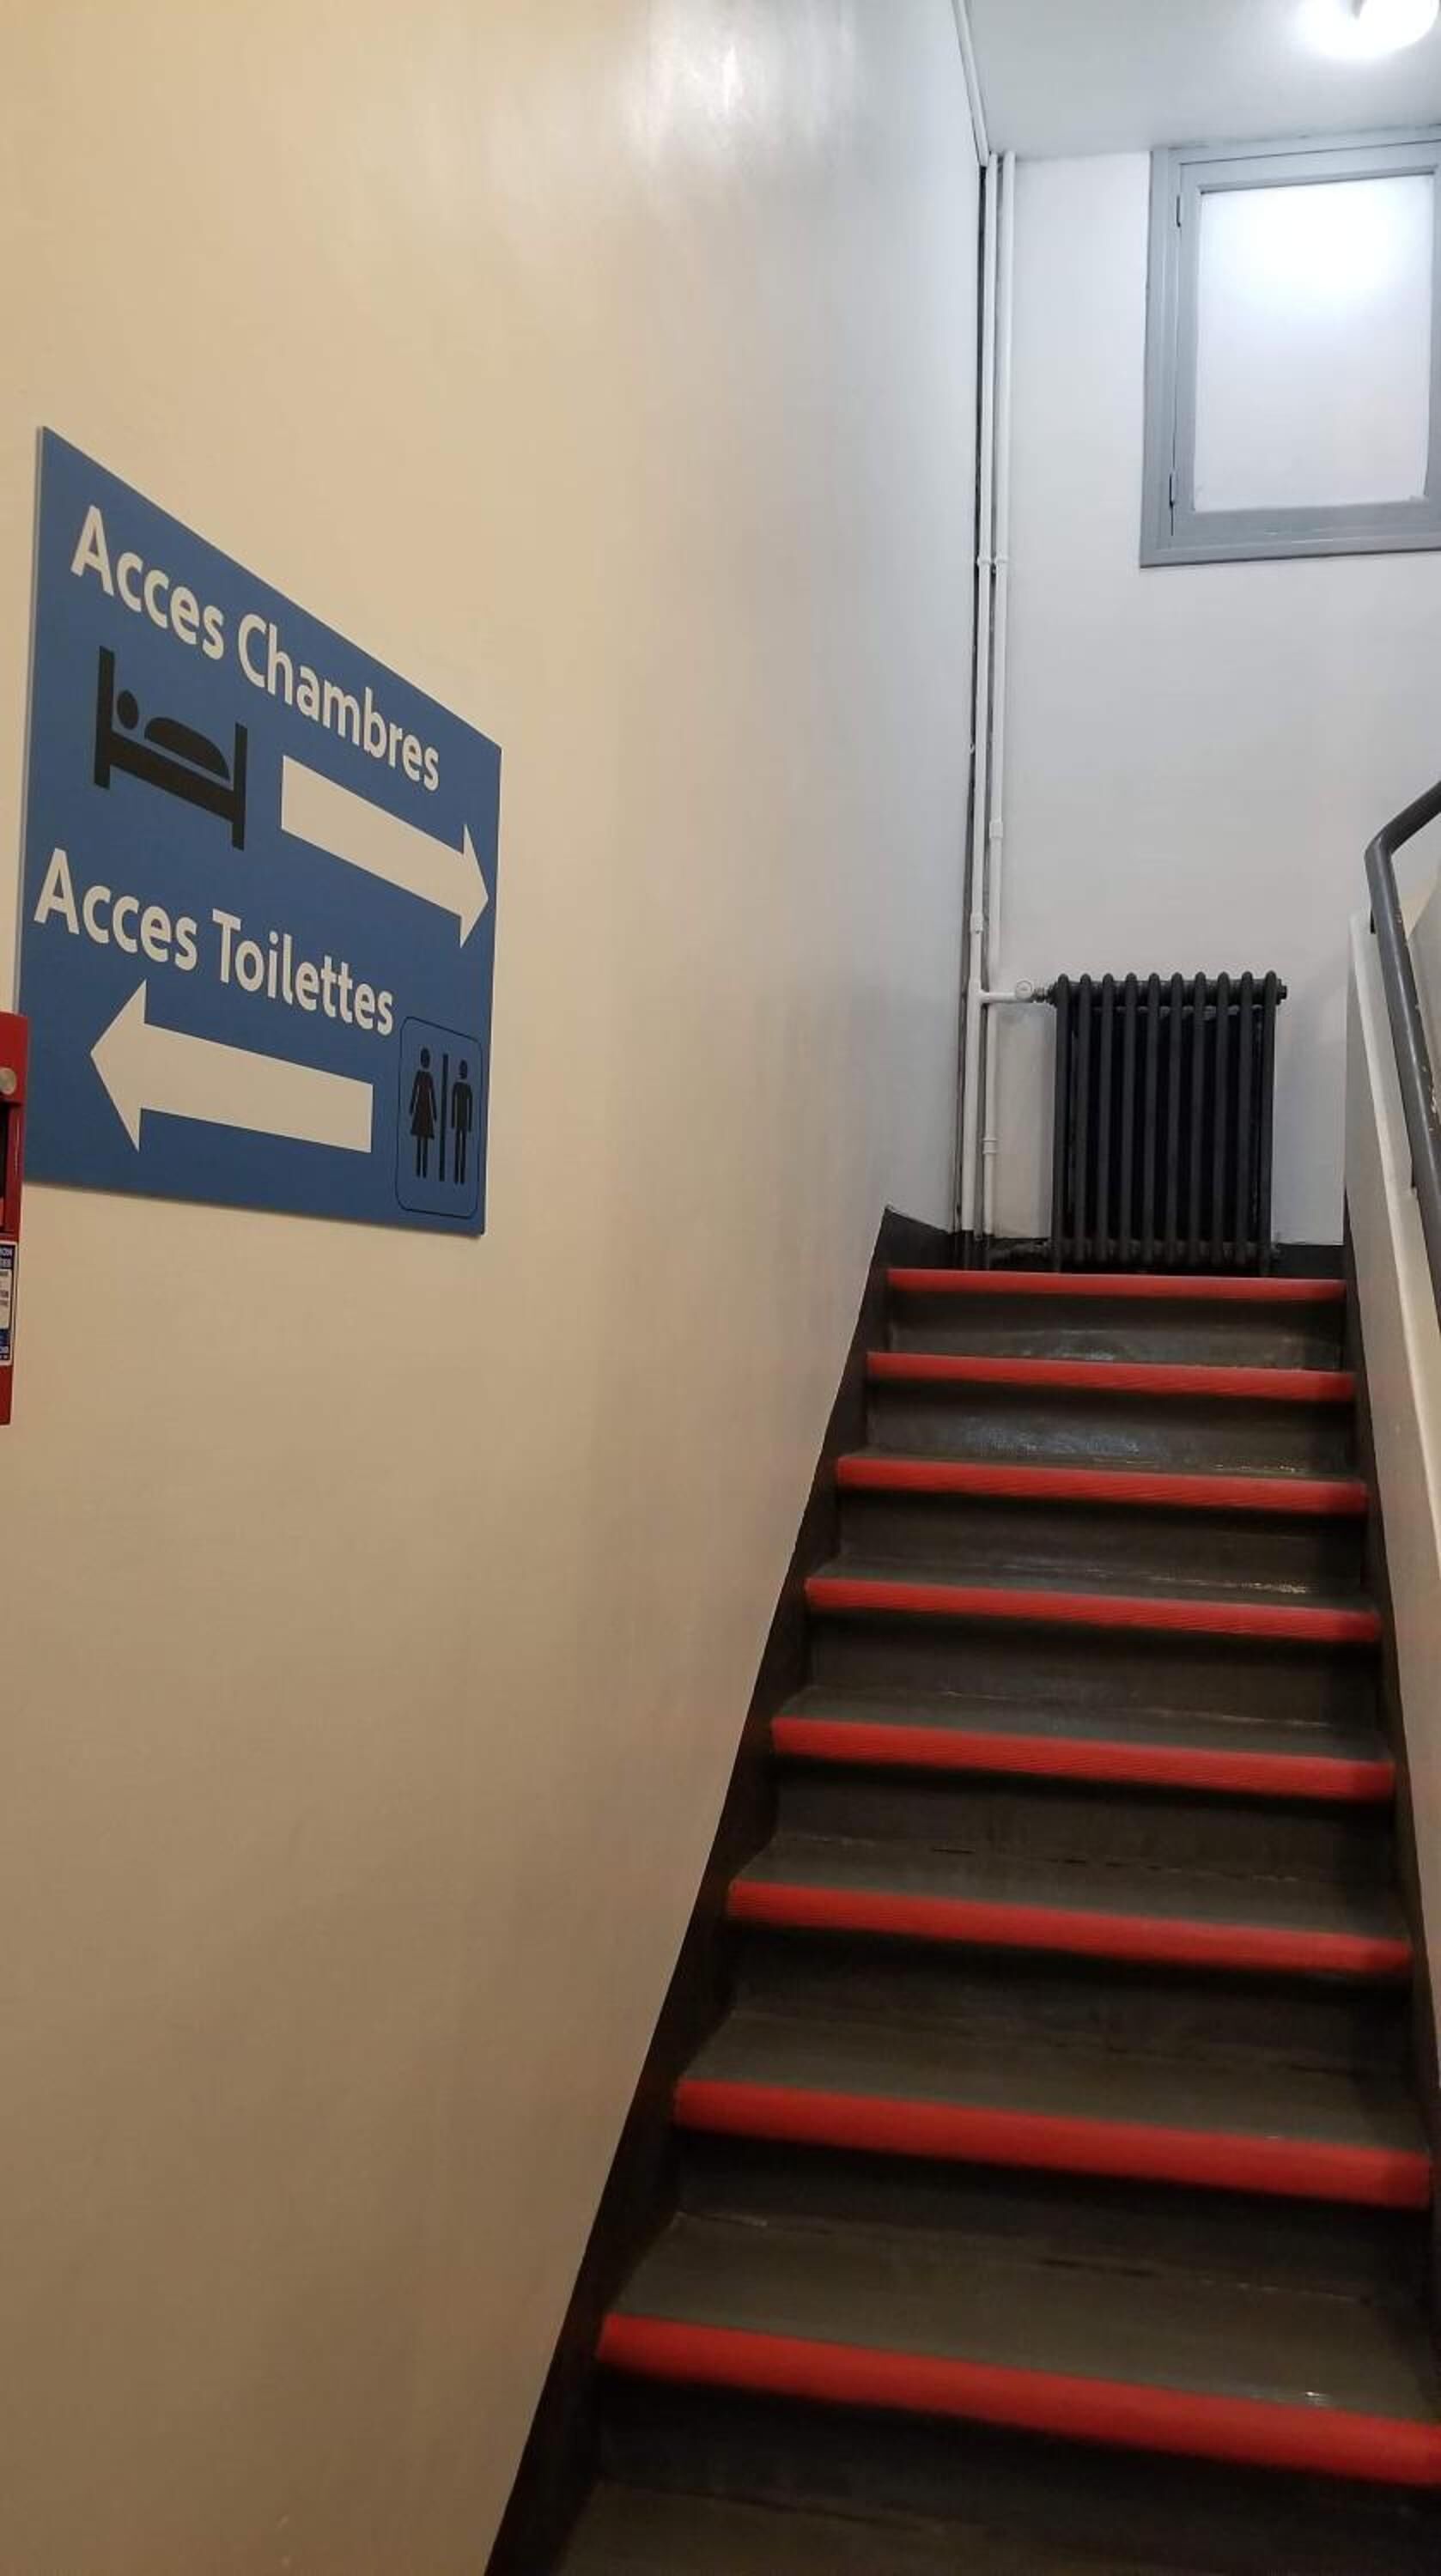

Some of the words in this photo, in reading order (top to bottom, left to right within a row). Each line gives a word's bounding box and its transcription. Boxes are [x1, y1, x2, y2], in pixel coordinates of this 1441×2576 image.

[70, 505, 224, 660] Acces
[238, 613, 440, 792] Chambres
[33, 848, 198, 972] Acces
[212, 908, 394, 1036] Toilettes
